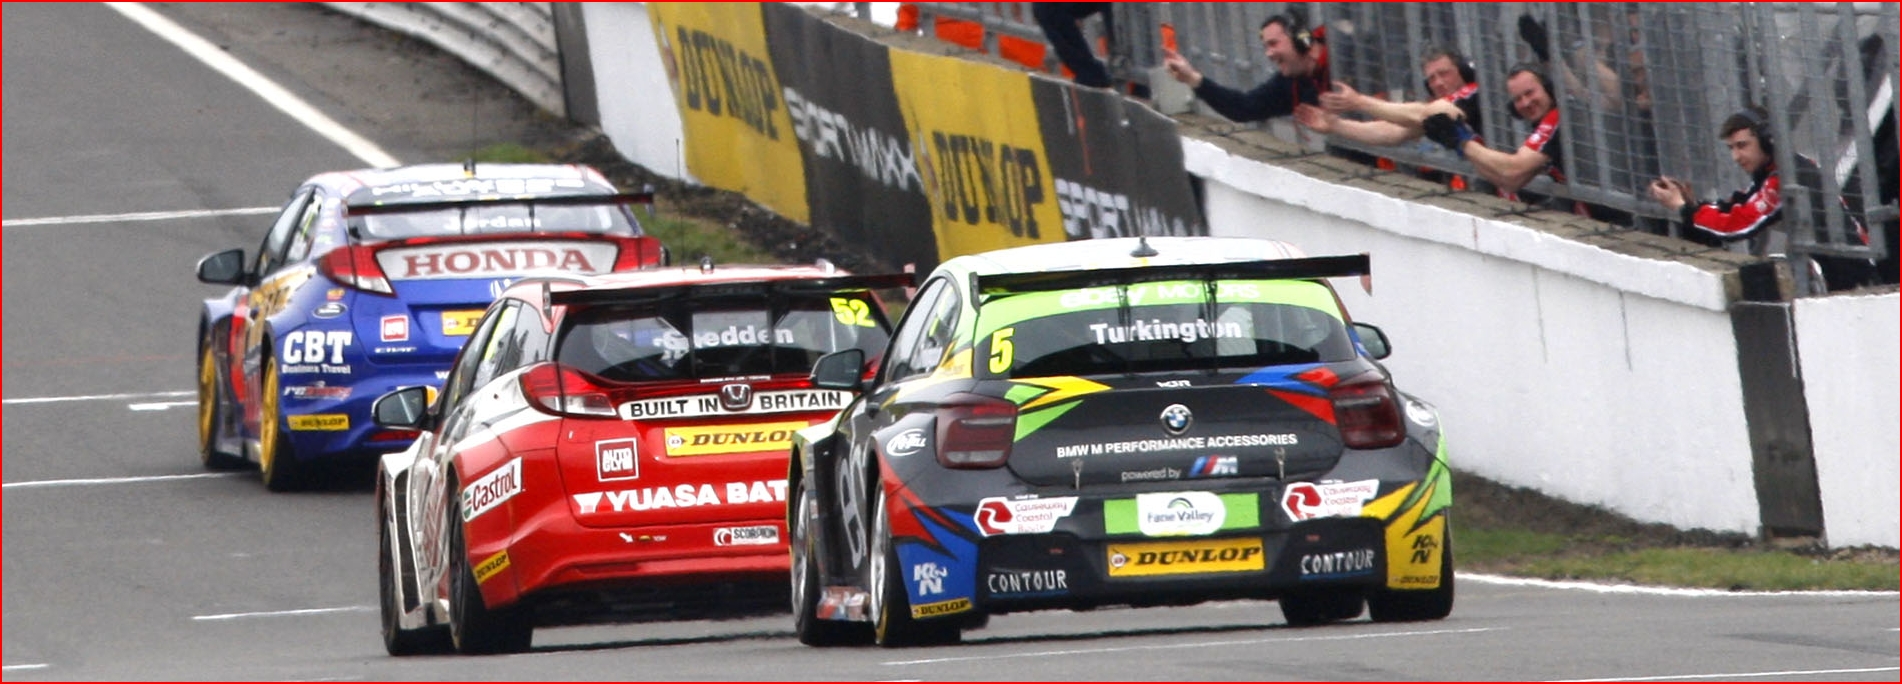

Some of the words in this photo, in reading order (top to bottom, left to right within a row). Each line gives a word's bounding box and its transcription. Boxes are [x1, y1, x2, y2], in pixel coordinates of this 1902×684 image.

[677, 25, 779, 140] DUNLOP
[933, 130, 1045, 240] DUNLOP
[403, 248, 595, 277] HONDA
[1158, 283, 1260, 300] MOORS
[829, 297, 876, 327] 52
[1089, 318, 1242, 345] Turkington
[283, 331, 352, 364] CBT
[988, 327, 1014, 374] 5
[630, 400, 688, 418] BUILT
[699, 397, 719, 413] IN
[760, 392, 842, 410] BRITAIN
[300, 418, 346, 427] DUNLOP
[1057, 445, 1089, 458] BMW
[1091, 443, 1103, 455] M
[1105, 436, 1205, 454] PERFORMANCE
[1207, 433, 1298, 449] ACCESSORIES
[1121, 467, 1166, 482] powered
[1168, 466, 1181, 479] by
[472, 464, 518, 511] Castrol
[605, 483, 721, 512] YUASA
[726, 479, 789, 504] BAT
[1147, 512, 1176, 523] Fane
[1177, 508, 1214, 522] Valley
[476, 554, 508, 581] DUNLOP
[1134, 547, 1261, 566] DUNLOP
[1300, 550, 1375, 574] CONTOUR
[988, 570, 1068, 593] CONTOUR
[920, 600, 969, 615] DUNLOP
